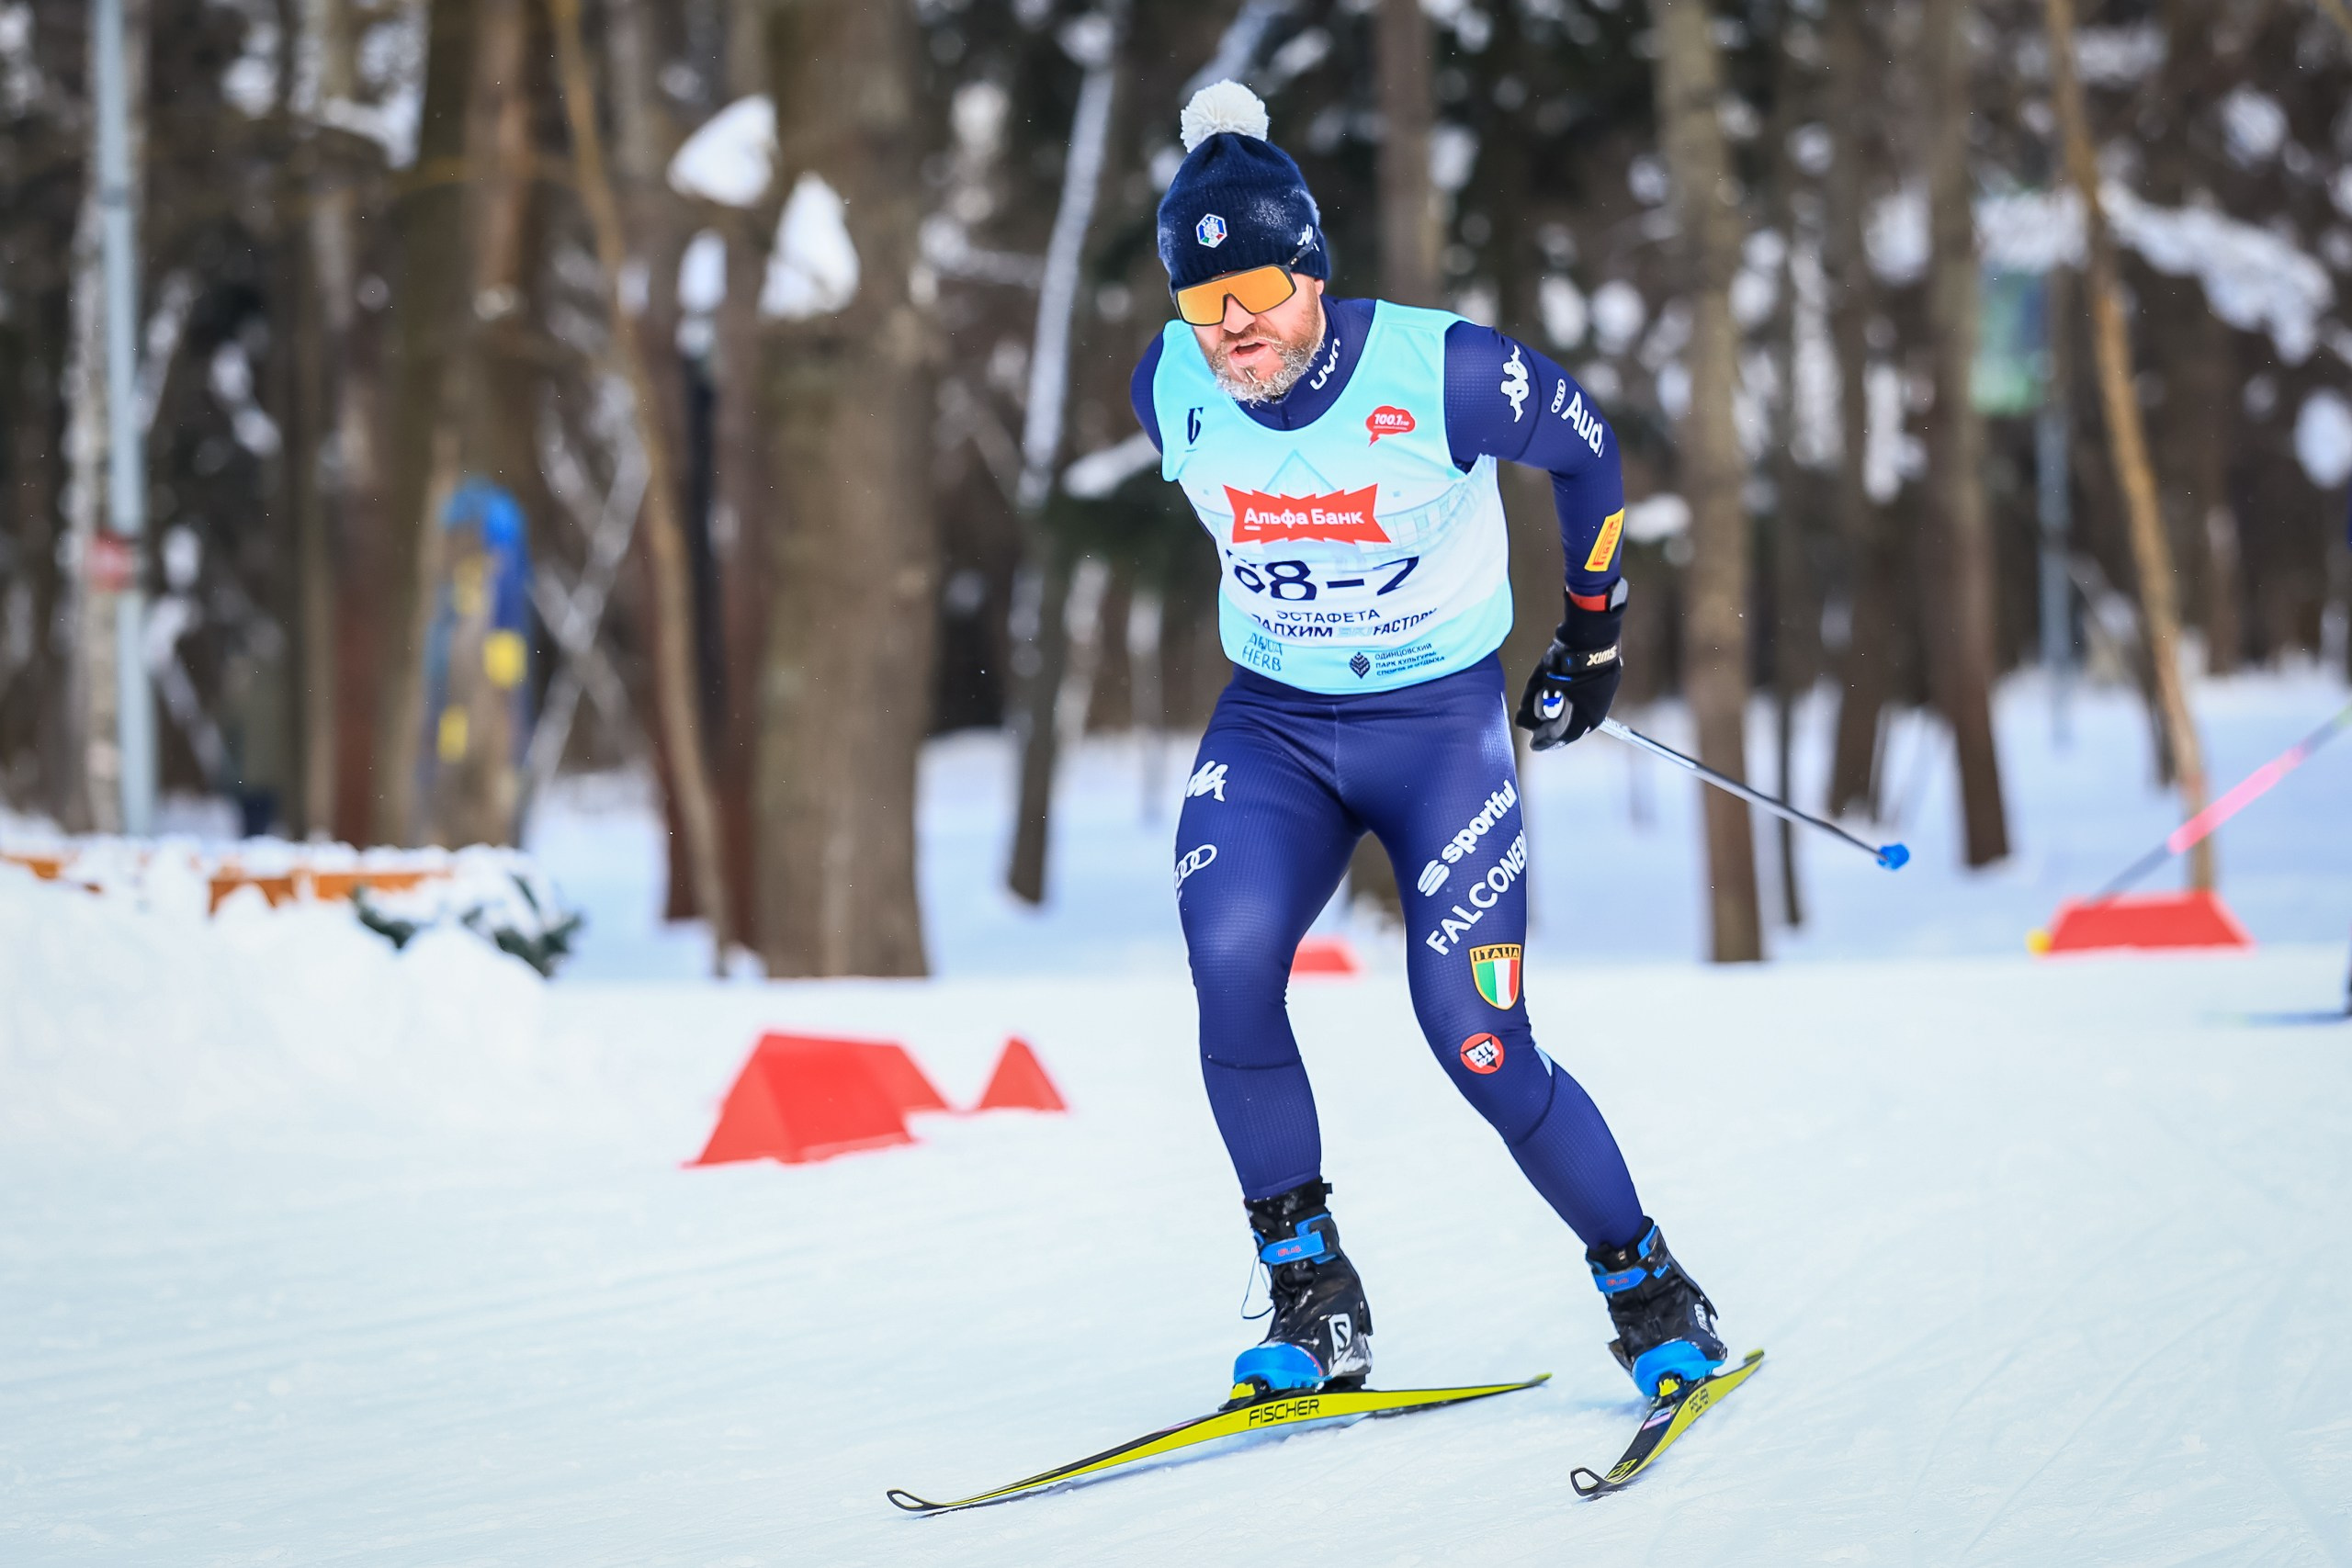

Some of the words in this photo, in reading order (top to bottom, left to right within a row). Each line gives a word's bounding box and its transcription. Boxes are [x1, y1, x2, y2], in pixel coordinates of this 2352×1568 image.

[1244, 507, 1309, 529] Альфа
[1310, 508, 1365, 525] Банк
[1276, 608, 1381, 624] ЭСТАФЕТА
[1242, 645, 1282, 672] HERB
[1474, 947, 1521, 962] ITALIA
[1249, 1398, 1320, 1427] FISCHER
